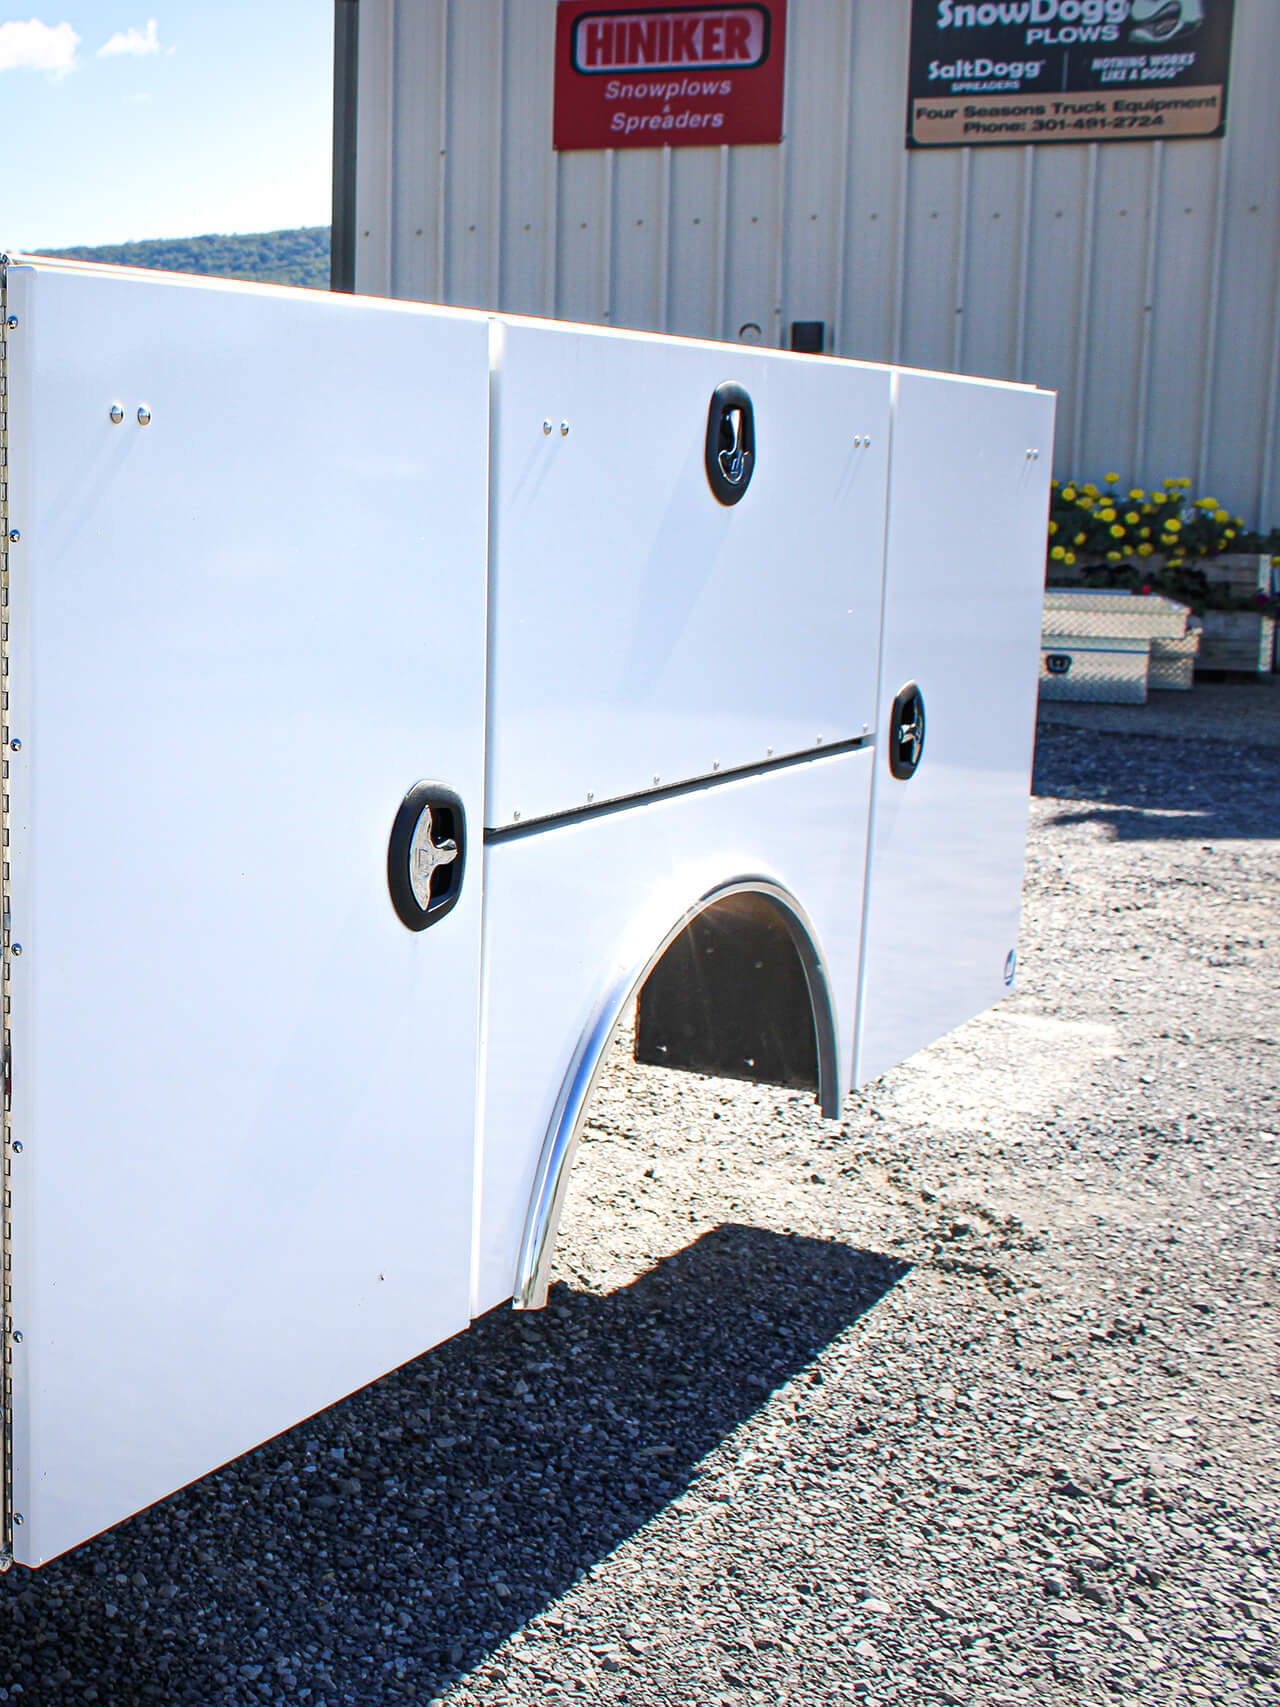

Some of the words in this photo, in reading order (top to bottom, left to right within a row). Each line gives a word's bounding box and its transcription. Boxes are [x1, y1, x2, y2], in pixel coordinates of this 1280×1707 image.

[936, 0, 1130, 29] SnowDogg
[585, 16, 752, 66] HINIKER
[1025, 25, 1120, 45] PLOWS
[927, 58, 1042, 80] SaltDogg
[1091, 55, 1148, 70] NOTHING
[1149, 52, 1197, 66] WORKS
[951, 80, 1021, 93] SPREADERS
[1100, 69, 1127, 82] LIKE
[1128, 69, 1139, 80] A
[605, 79, 732, 101] Snowplows
[916, 107, 958, 120] Four
[963, 104, 1046, 118] Seasons
[1052, 101, 1106, 115] Truck
[1112, 95, 1217, 114] Equipment
[610, 111, 724, 134] Spreaders
[963, 120, 1026, 134] Phone:
